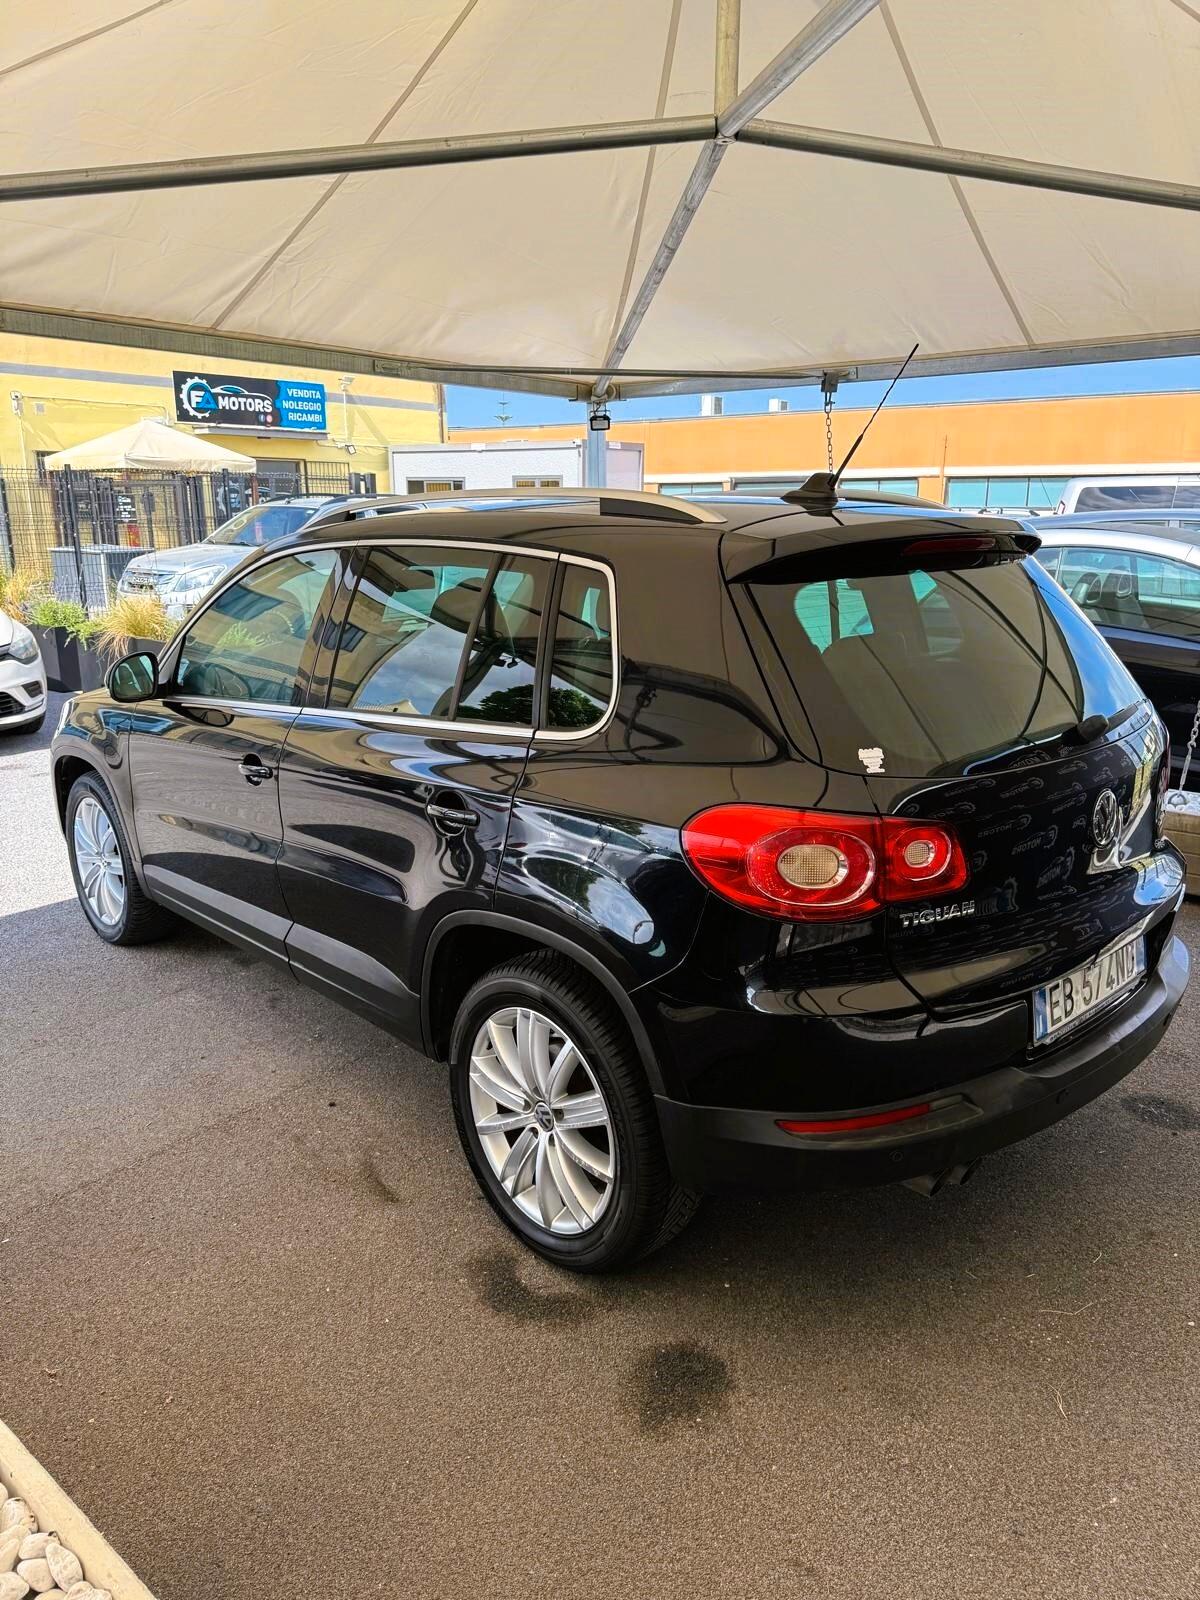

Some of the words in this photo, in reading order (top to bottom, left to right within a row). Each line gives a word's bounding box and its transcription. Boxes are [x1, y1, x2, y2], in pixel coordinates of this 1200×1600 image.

[287, 388, 321, 399] VENDITA
[218, 396, 273, 412] MOTORS
[282, 400, 322, 411] NOLEGGIO
[288, 411, 322, 422] RICAMBI
[899, 900, 975, 928] TIGUAN
